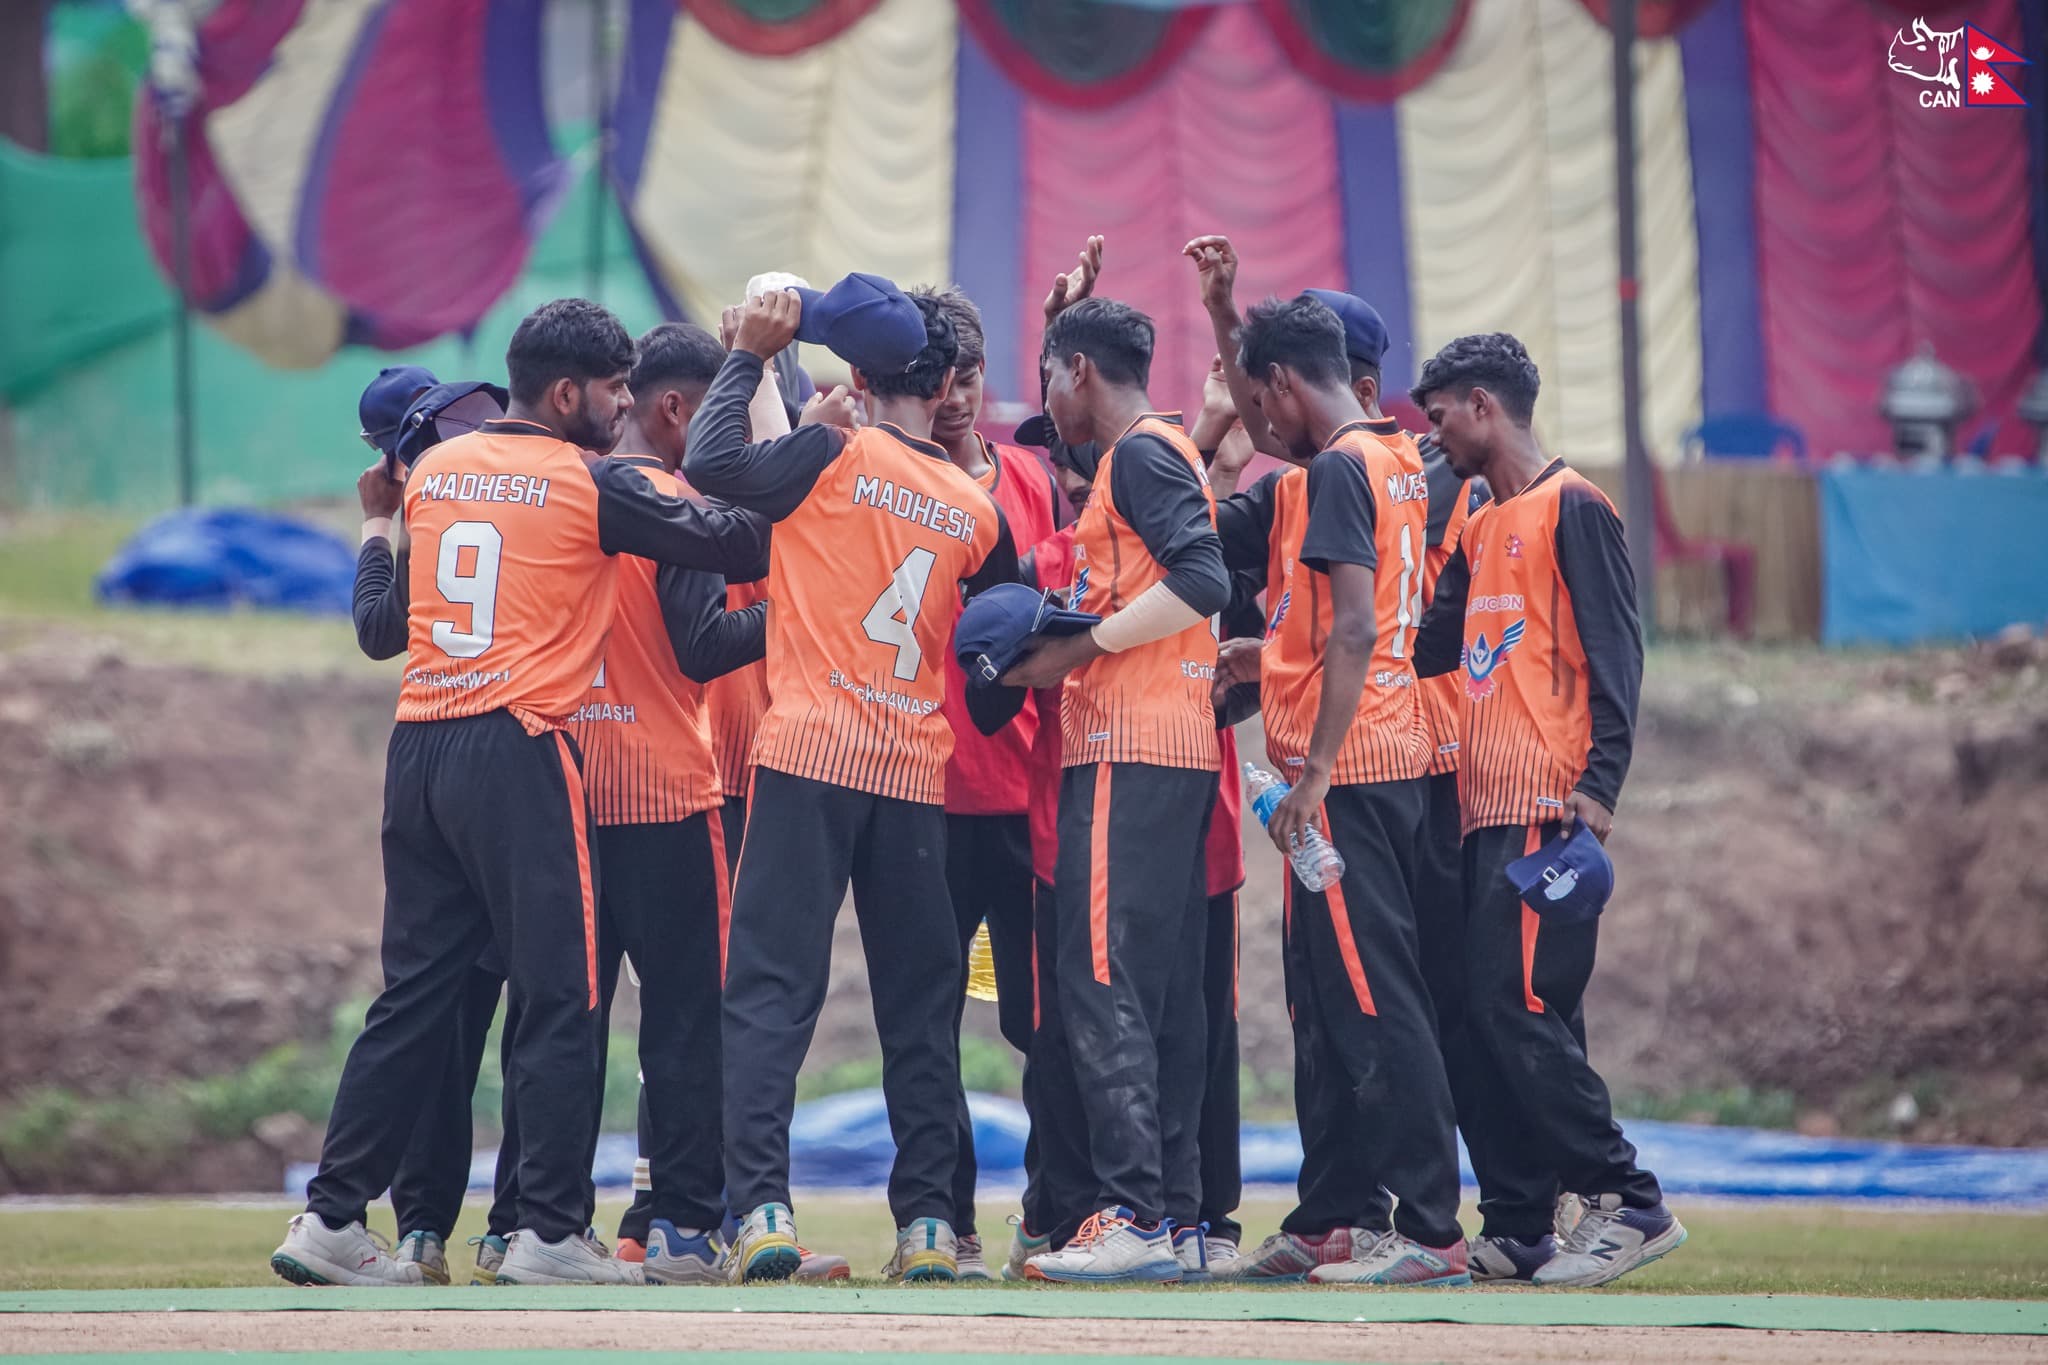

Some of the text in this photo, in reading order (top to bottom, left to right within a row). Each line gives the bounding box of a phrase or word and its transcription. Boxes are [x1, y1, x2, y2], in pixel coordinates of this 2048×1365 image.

[420, 473, 549, 507] MADHESH
[853, 474, 976, 545] MADHESH
[431, 520, 503, 658] 9
[861, 546, 937, 682] 4
